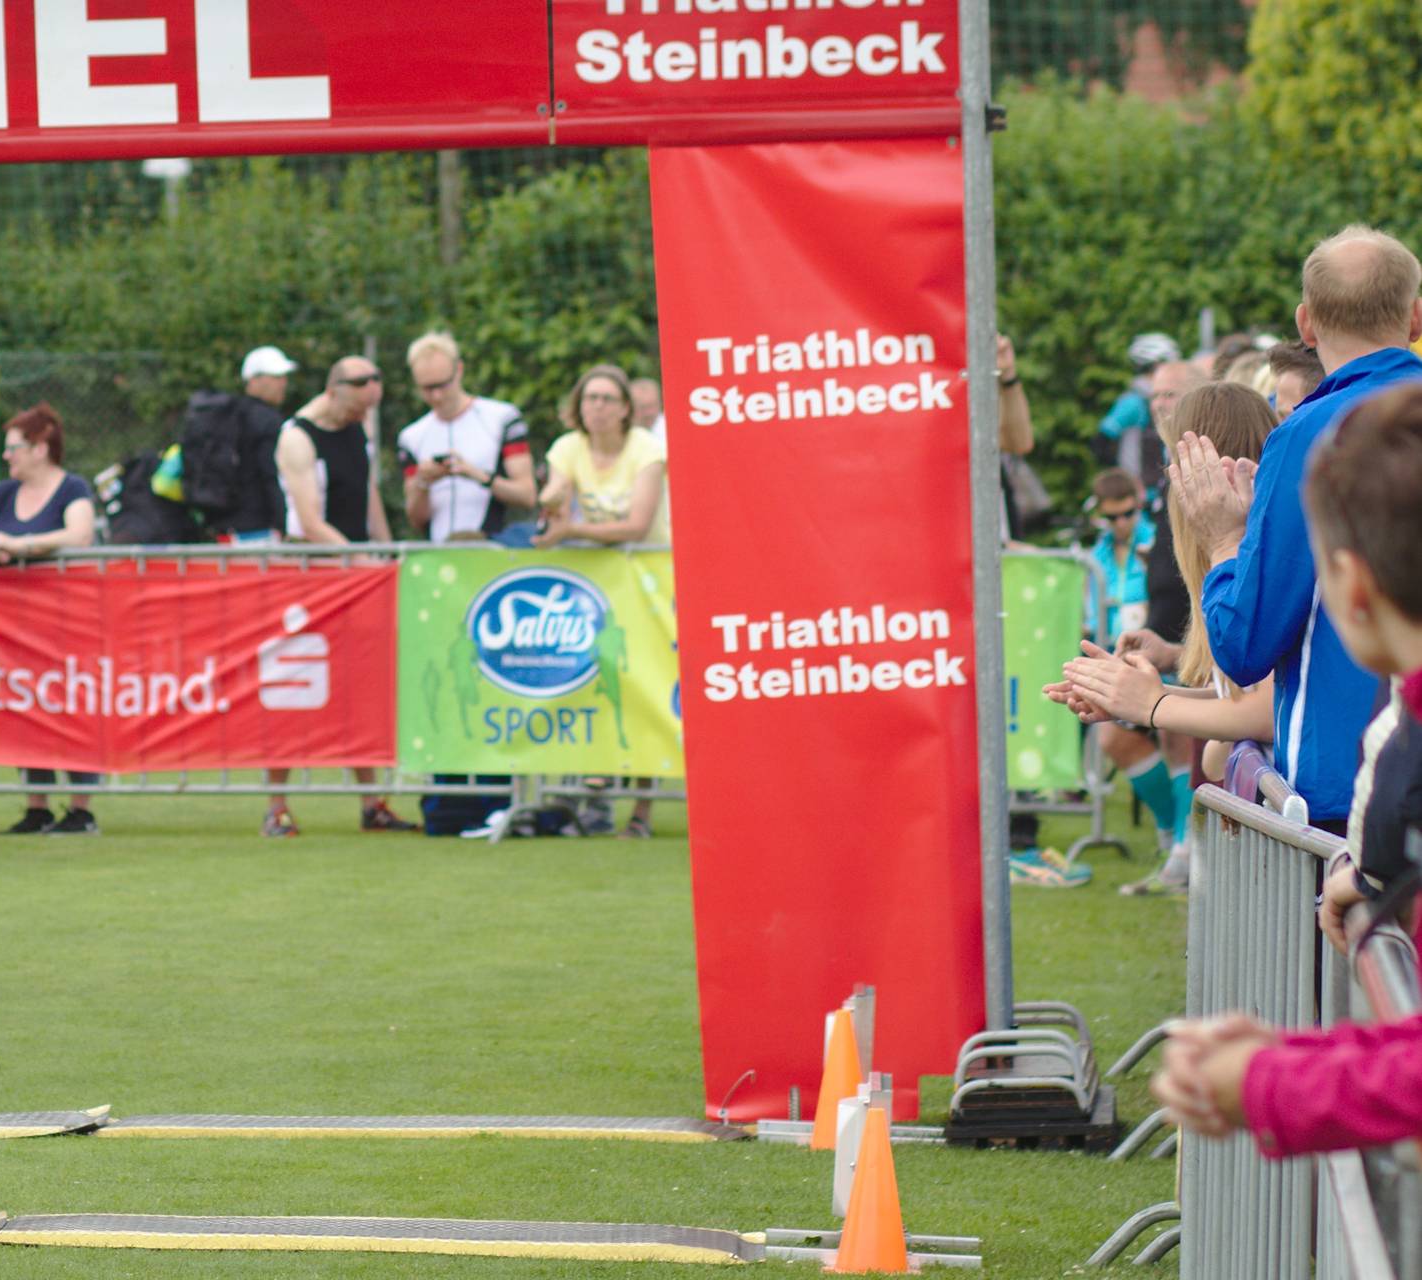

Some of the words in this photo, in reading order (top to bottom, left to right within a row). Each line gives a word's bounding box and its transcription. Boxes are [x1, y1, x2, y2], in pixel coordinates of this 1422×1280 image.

[575, 20, 946, 83] Steinbeck
[697, 329, 935, 376] Triathlon
[689, 373, 953, 426] Steinbeck
[712, 605, 950, 653] Triathlon
[704, 649, 966, 701] Steinbeck
[483, 706, 598, 745] SPORT
